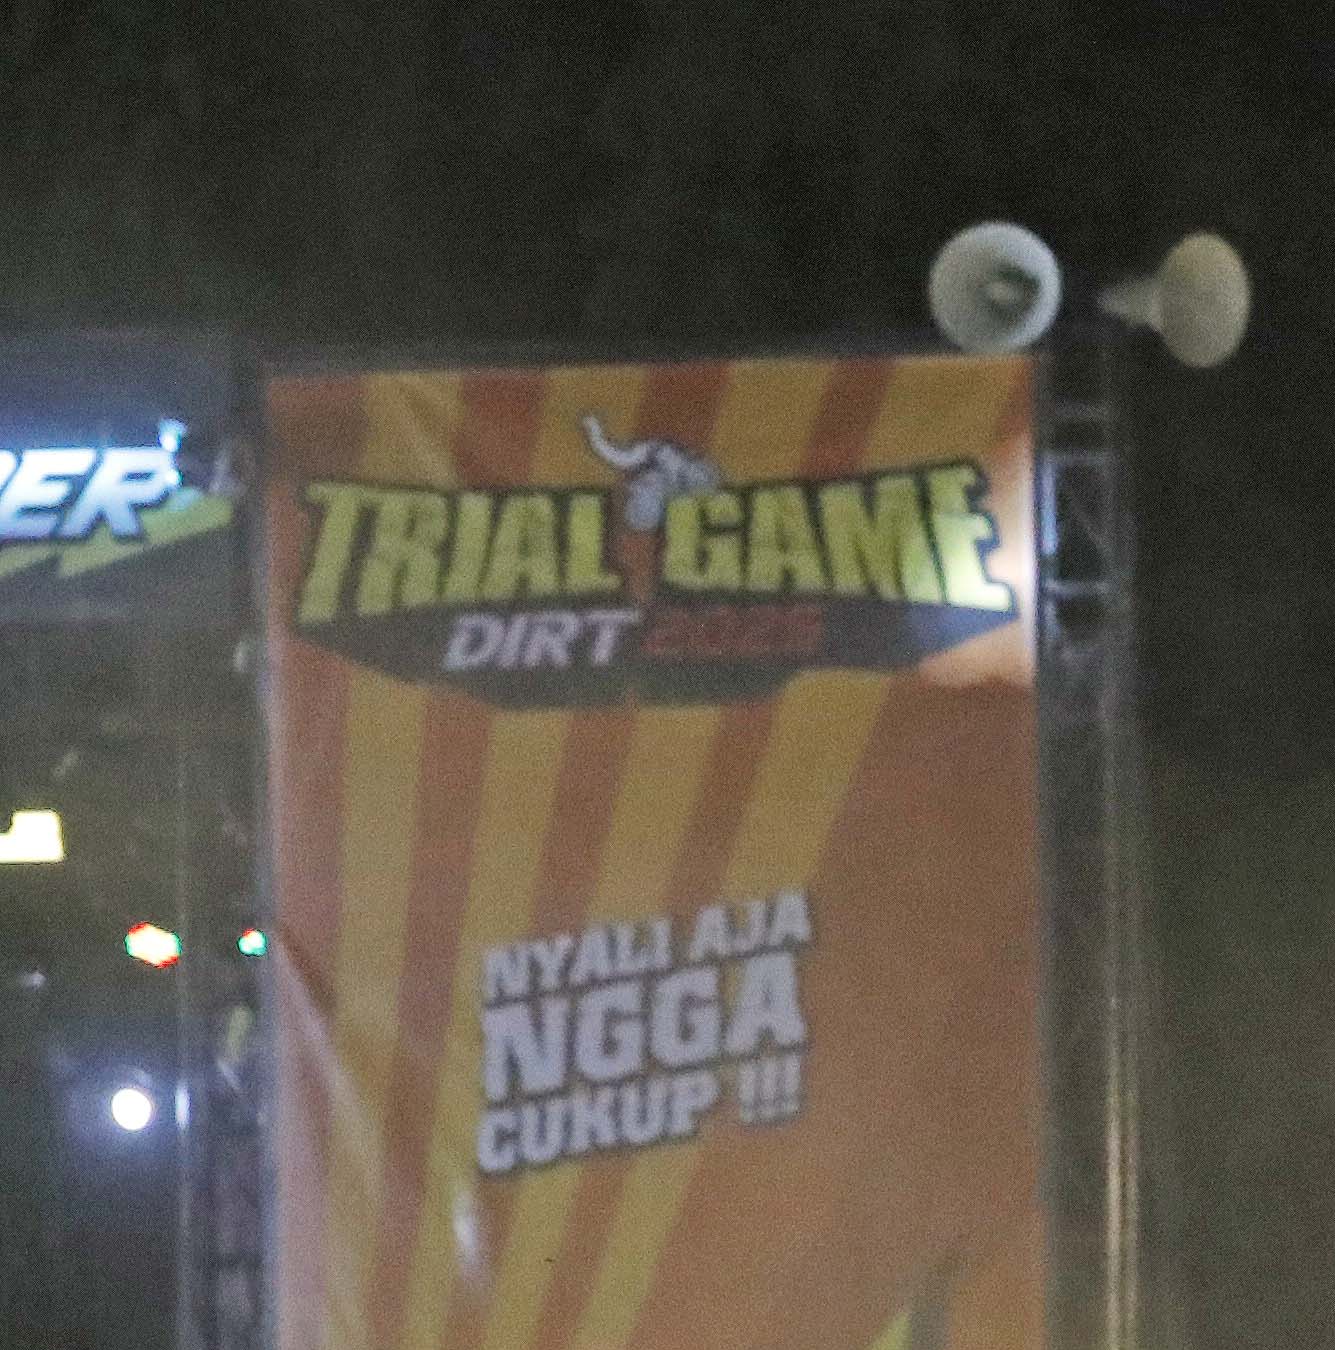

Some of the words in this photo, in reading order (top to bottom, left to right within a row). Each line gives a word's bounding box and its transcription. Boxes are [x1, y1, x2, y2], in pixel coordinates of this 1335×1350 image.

[0, 447, 177, 540] ER
[295, 483, 624, 627] TRIAL
[656, 464, 1013, 611] GAME
[443, 609, 640, 671] DIRT
[482, 917, 673, 1001] NYALI
[689, 887, 813, 962] AJA
[482, 952, 808, 1102] NGGA
[477, 1070, 721, 1173] CUKUP
